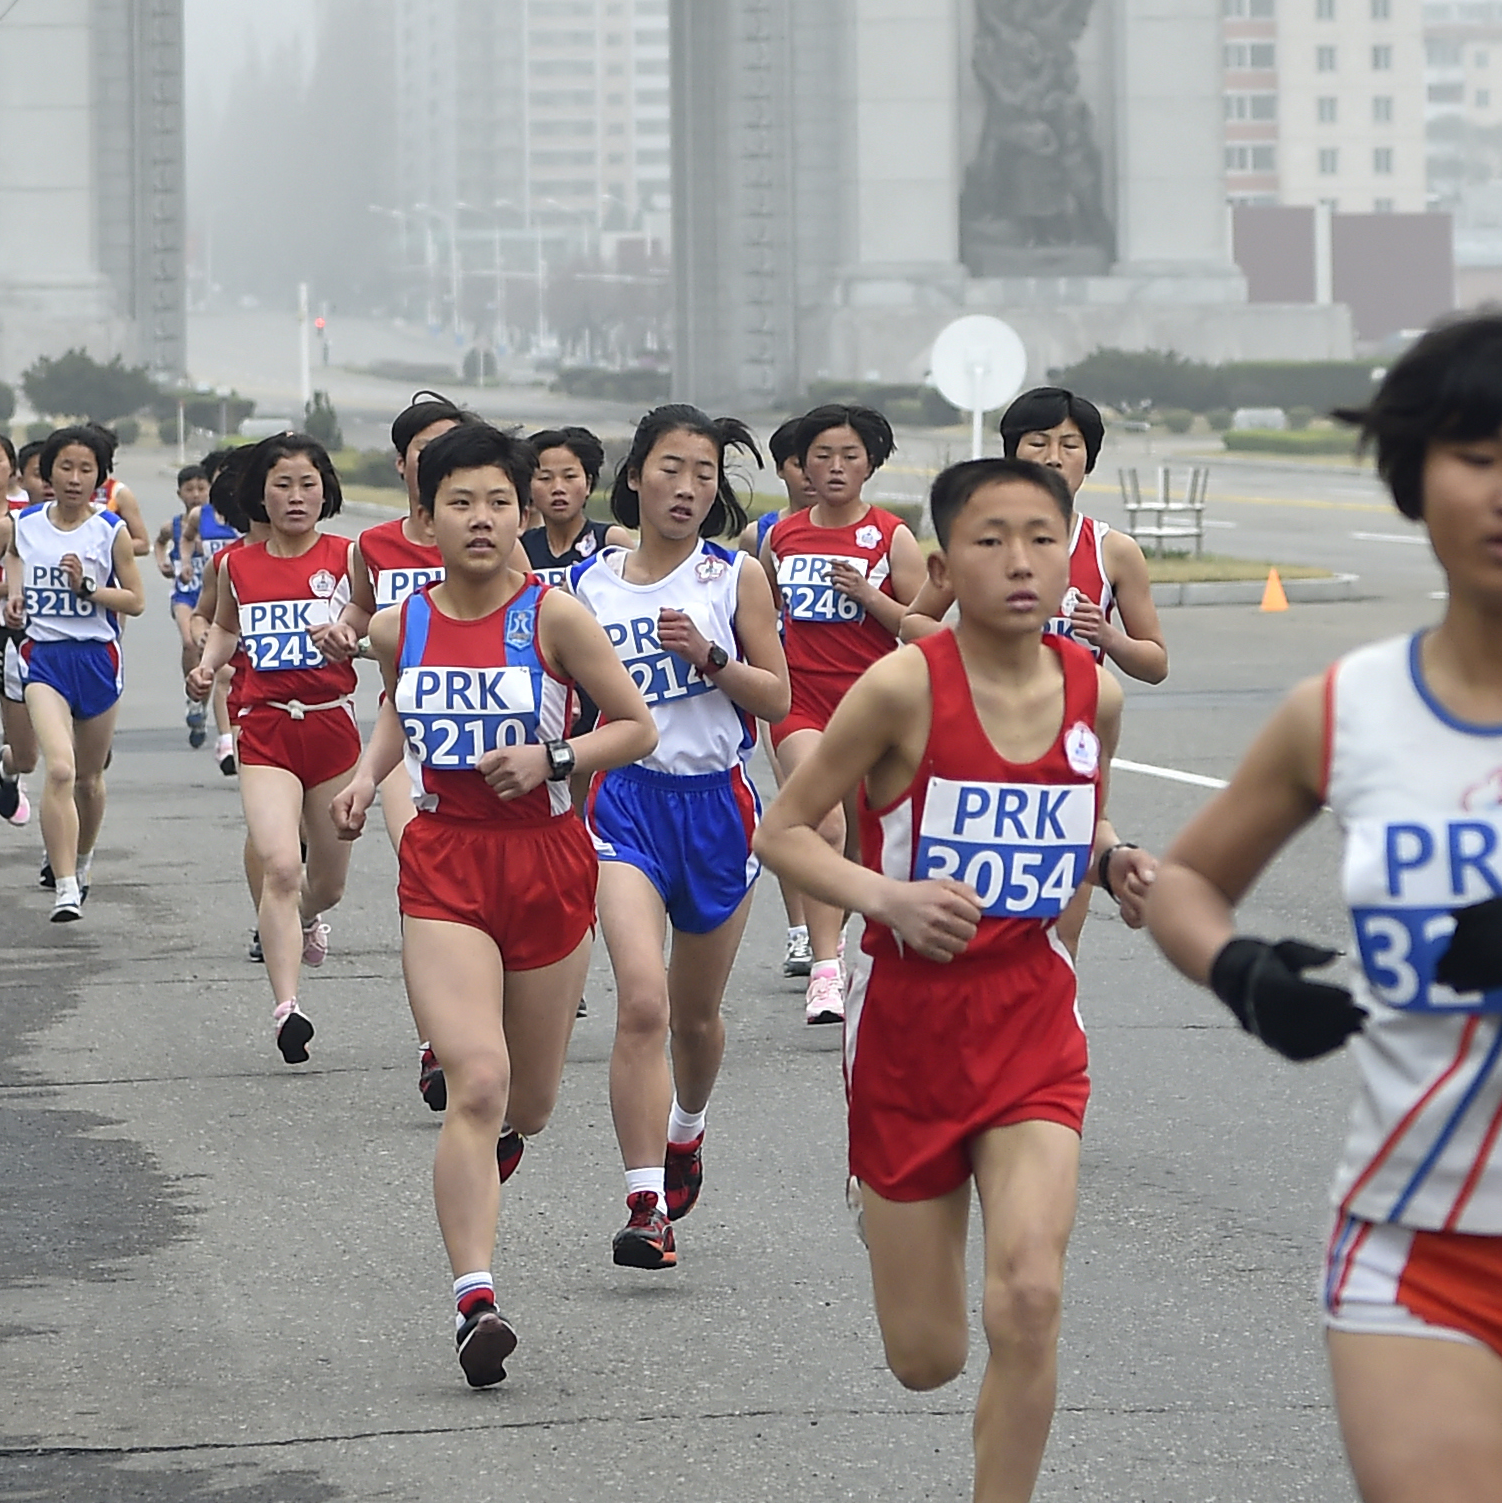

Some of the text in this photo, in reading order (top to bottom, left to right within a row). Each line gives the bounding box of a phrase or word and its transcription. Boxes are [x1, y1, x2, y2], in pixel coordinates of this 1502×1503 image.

[33, 566, 72, 588] PR
[790, 558, 839, 583] PR
[26, 590, 93, 617] 3216
[251, 602, 313, 632] PRK
[606, 613, 674, 654] PR
[414, 670, 510, 711] PRK
[953, 786, 1073, 840] PRK
